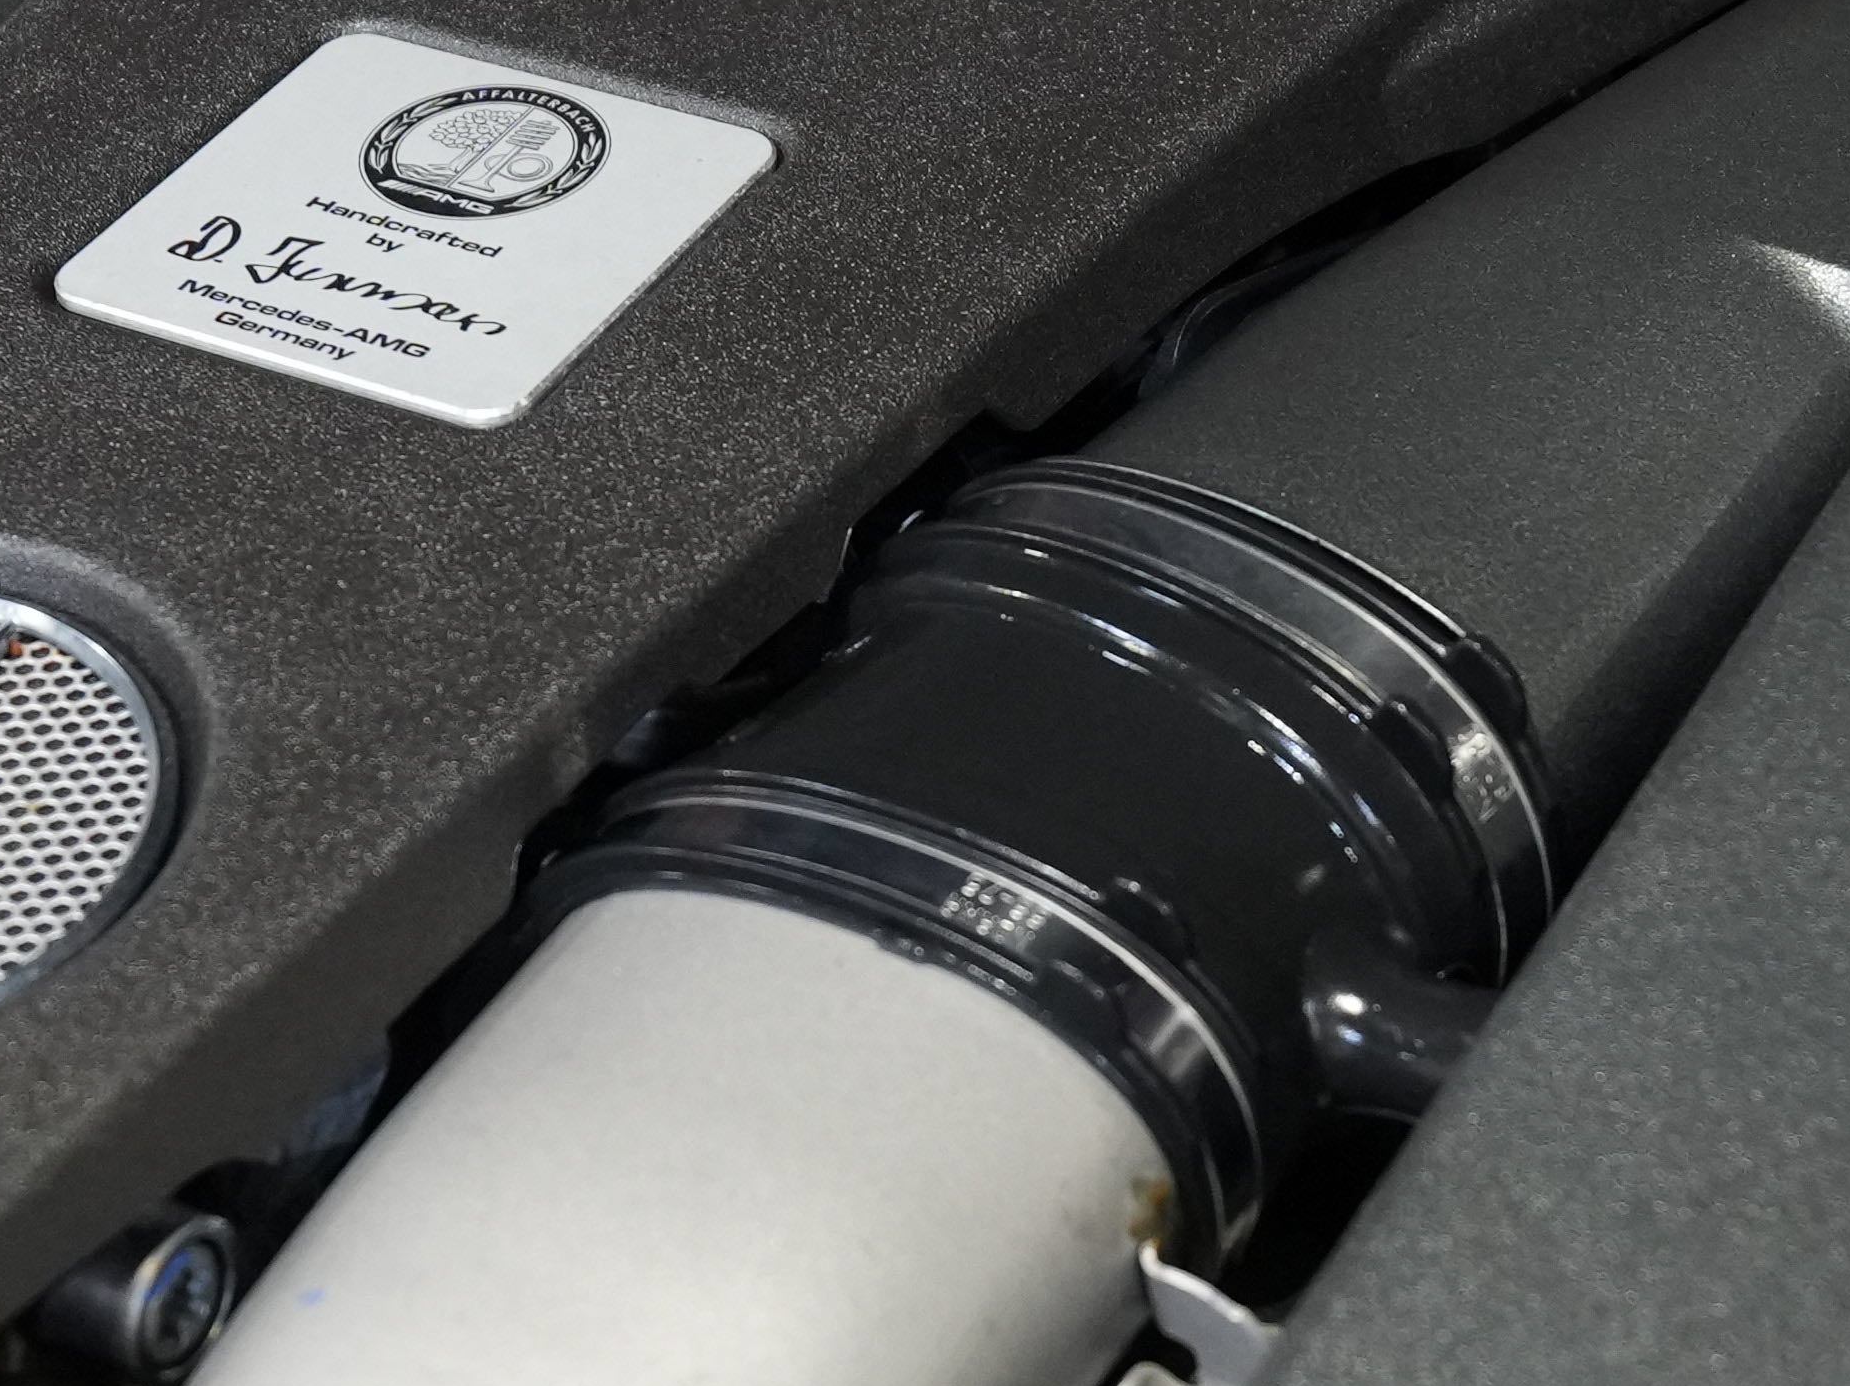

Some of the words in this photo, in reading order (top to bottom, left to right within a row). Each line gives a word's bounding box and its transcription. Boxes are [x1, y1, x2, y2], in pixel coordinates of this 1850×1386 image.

[461, 90, 596, 133] AFFALTERBACH
[305, 196, 503, 258] Handcrafted
[365, 233, 404, 253] by
[177, 279, 431, 358] Mercedes-AMG
[213, 310, 356, 361] Germany
